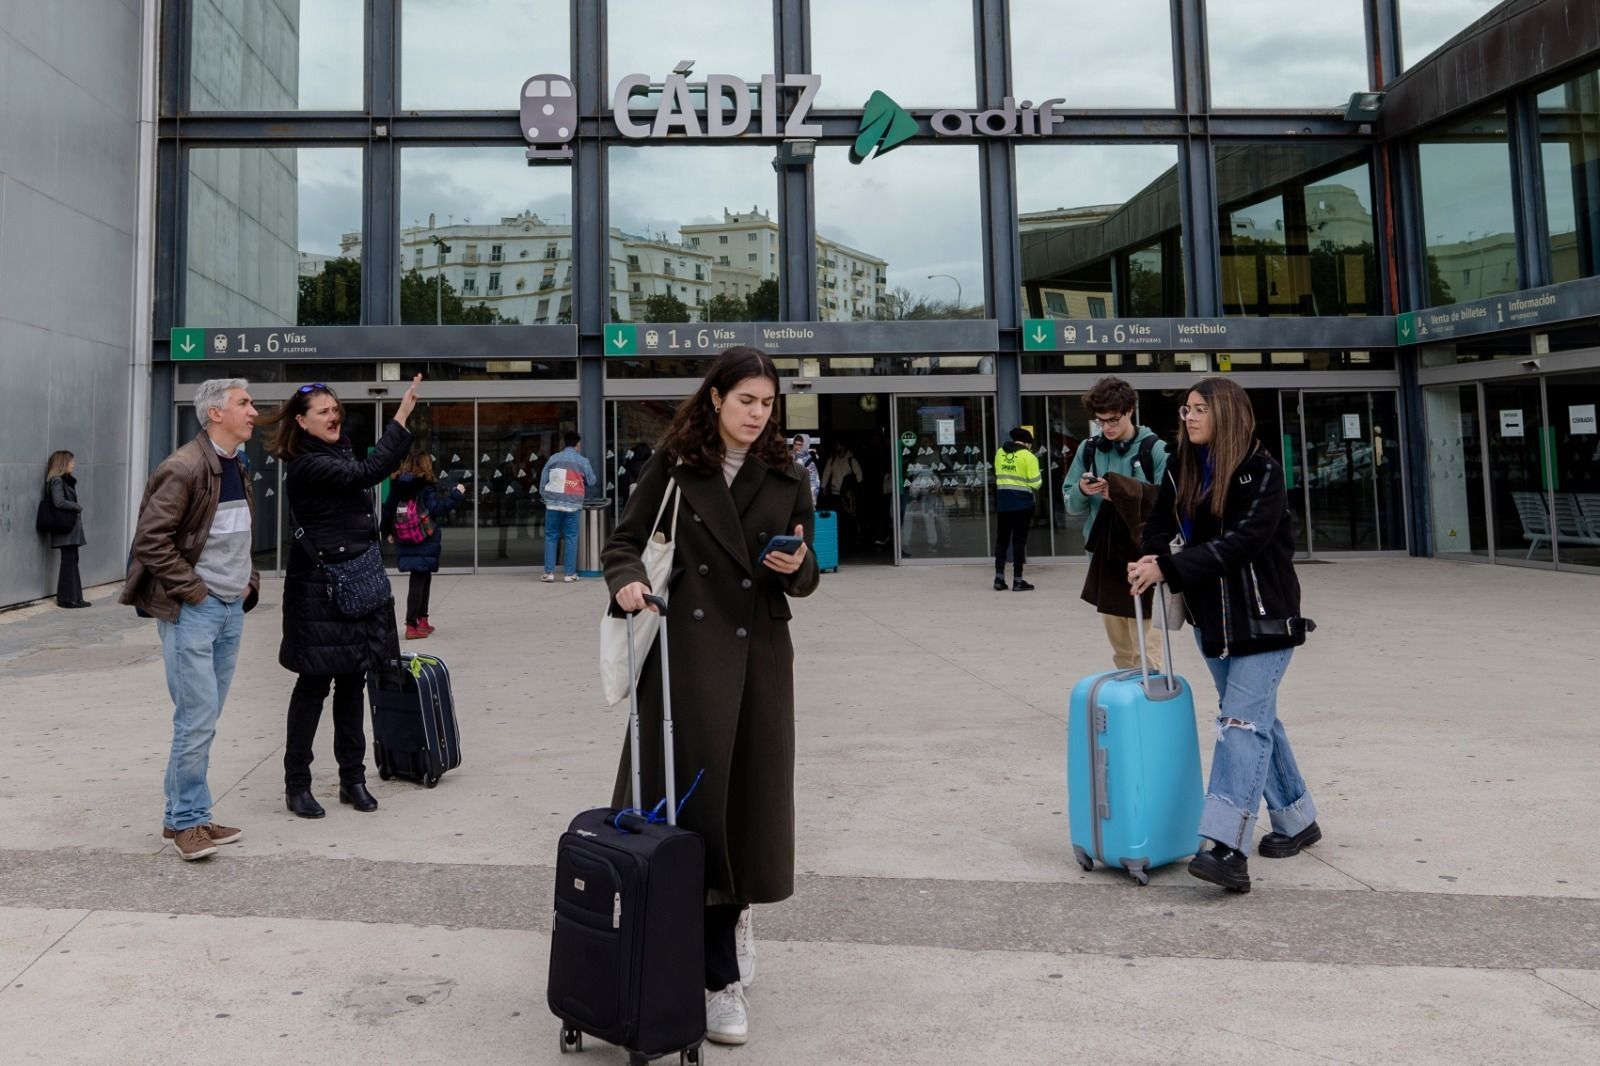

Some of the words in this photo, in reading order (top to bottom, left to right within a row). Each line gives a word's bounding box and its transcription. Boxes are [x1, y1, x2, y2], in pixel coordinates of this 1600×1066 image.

[612, 60, 823, 139] CÁDIZ
[930, 96, 1066, 137] adif
[1508, 292, 1557, 312] Información
[1431, 313, 1450, 324] Venta
[1451, 311, 1460, 322] de
[1460, 307, 1488, 320] billetes
[668, 329, 680, 348] 1
[684, 339, 692, 348] a
[697, 329, 709, 348] 6
[713, 328, 736, 339] Vías
[763, 328, 814, 339] Vestíbulo
[1085, 324, 1097, 343] 1
[1101, 334, 1109, 343] a
[1113, 324, 1126, 343] 6
[1128, 323, 1152, 335] Vías
[1177, 323, 1227, 334] Vestíbulo
[237, 333, 249, 353] 1
[253, 343, 261, 353] a
[266, 332, 280, 353] 6
[283, 332, 307, 344] Vías
